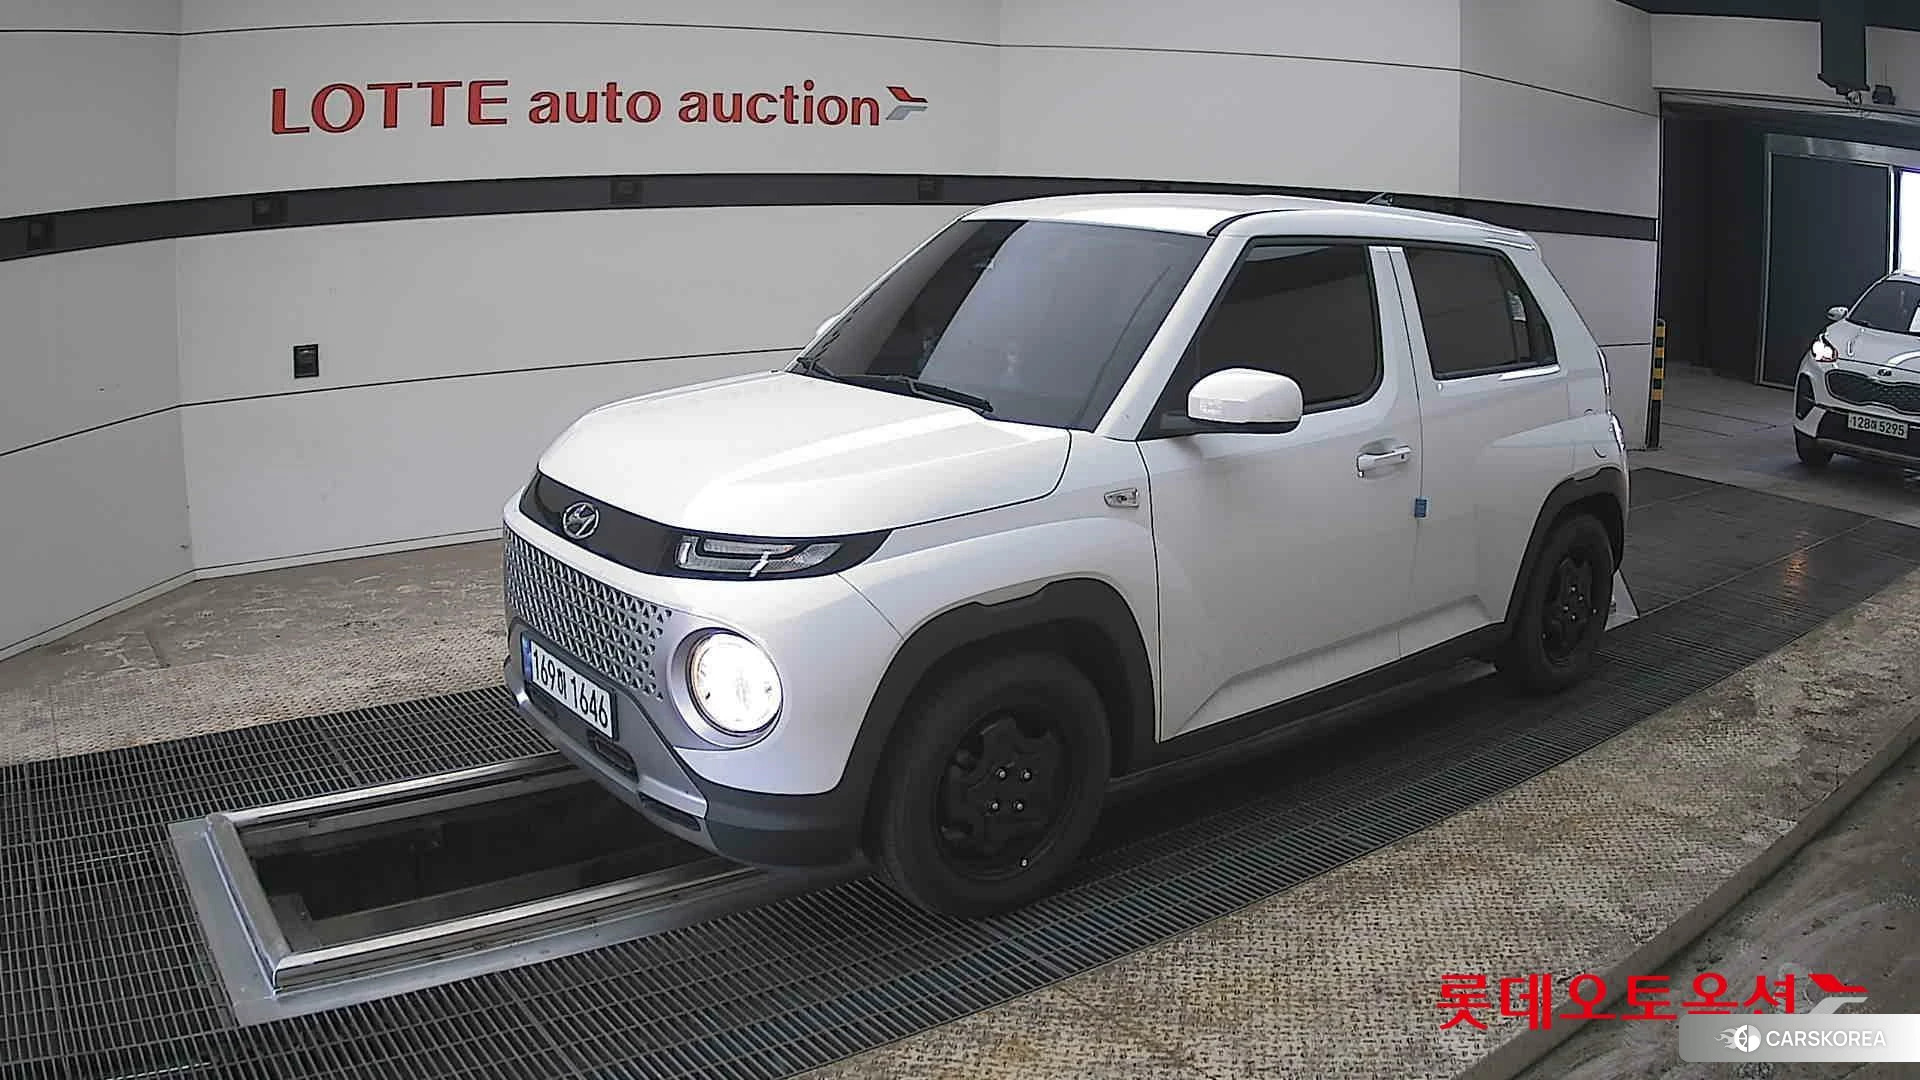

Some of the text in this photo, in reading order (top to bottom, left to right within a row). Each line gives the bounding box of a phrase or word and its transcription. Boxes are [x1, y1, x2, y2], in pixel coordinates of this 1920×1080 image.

[271, 79, 881, 135] LOTTE auto auction
[1880, 420, 1905, 436] 5295
[570, 676, 608, 729] 1646
